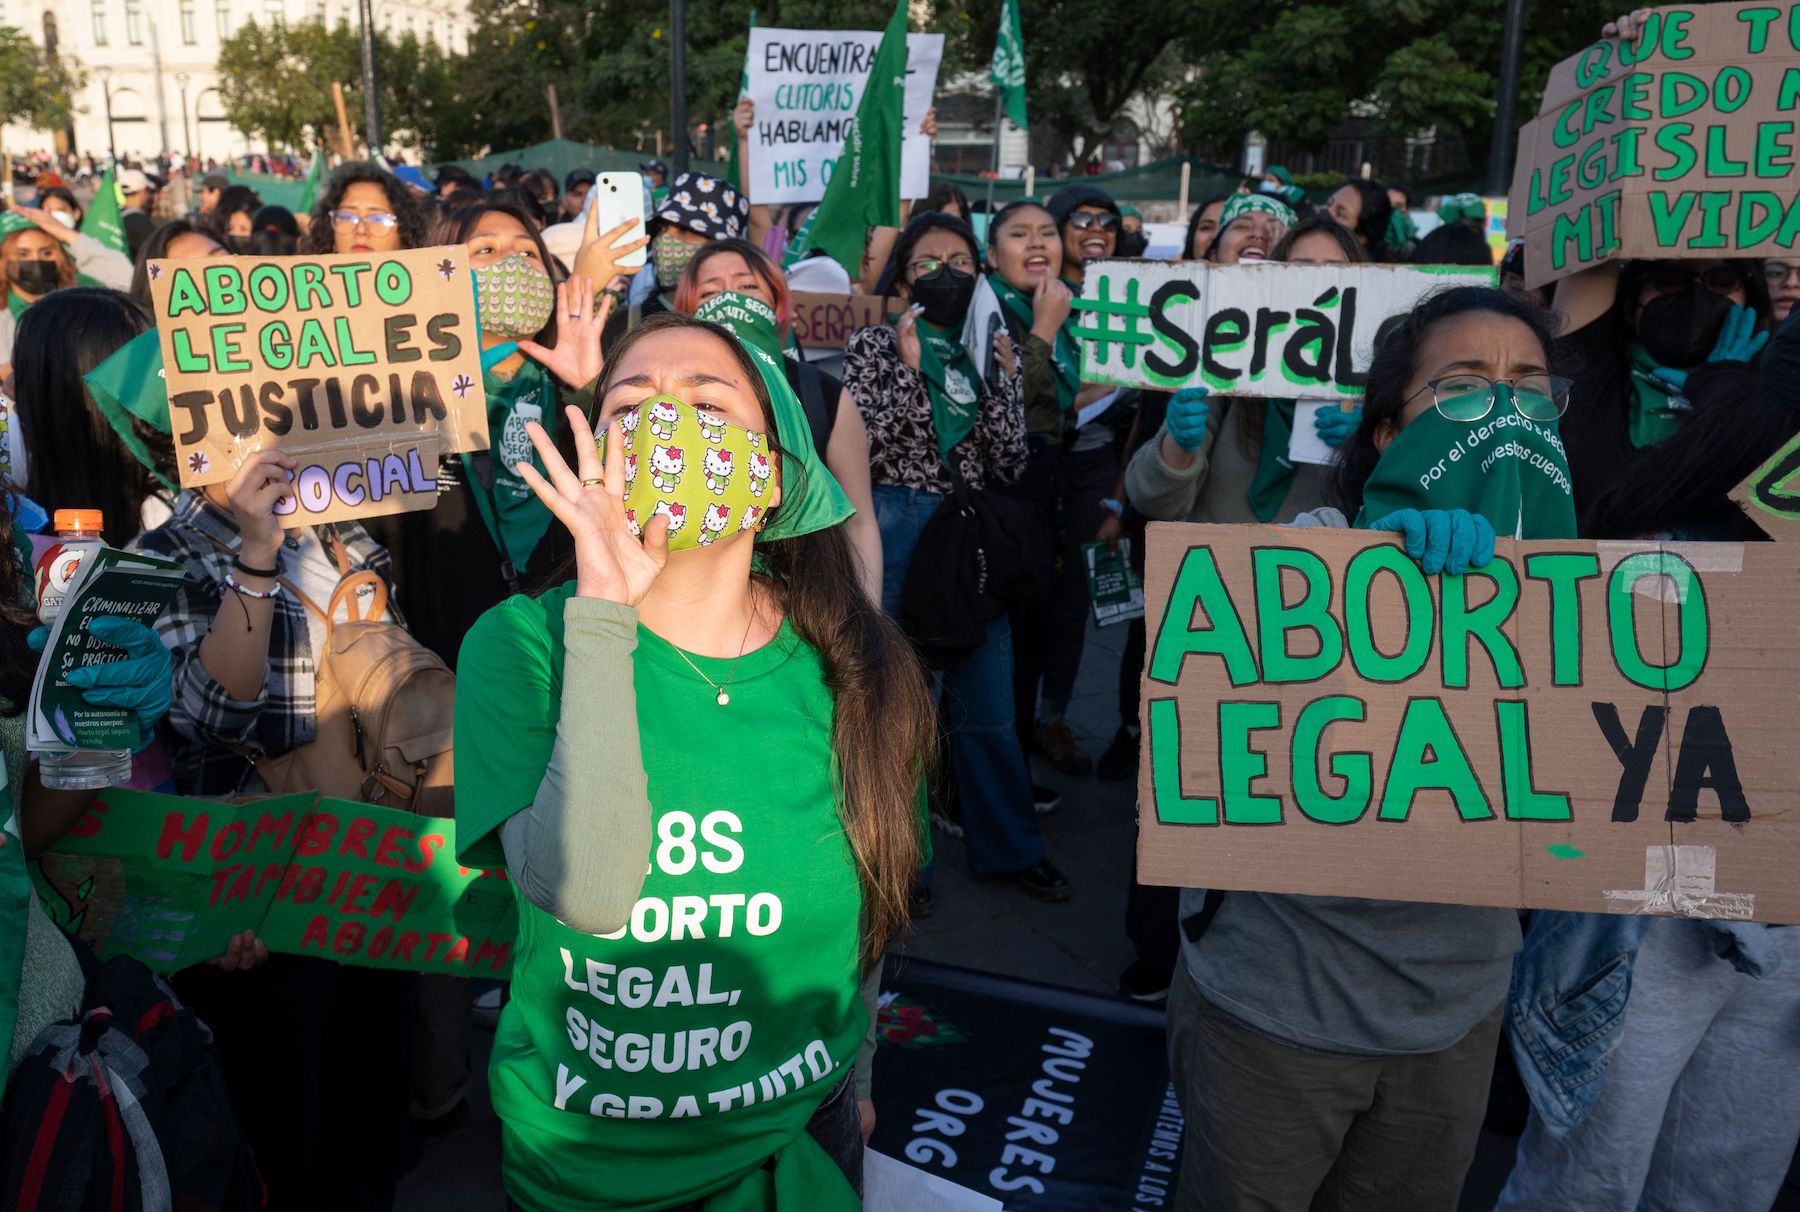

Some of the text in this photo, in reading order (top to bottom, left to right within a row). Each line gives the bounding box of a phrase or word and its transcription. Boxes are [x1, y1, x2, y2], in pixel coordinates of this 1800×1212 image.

[765, 42, 877, 75] ENCUENTRA
[1575, 10, 1696, 90] QUE
[775, 82, 854, 112] CLITORIS
[1552, 65, 1754, 149] CREDO
[774, 159, 807, 189] MIS
[1527, 120, 1795, 217] LEGISLE
[1551, 188, 1623, 271] MI
[168, 259, 413, 317] ABORTO
[704, 292, 740, 313] LEGAL
[171, 313, 462, 374] LEGAL ES
[794, 296, 855, 341] SERÁ
[169, 370, 447, 446] JUSTICIA
[1419, 458, 1447, 490] por
[1448, 441, 1466, 462] el
[1467, 412, 1533, 447] derecho
[1529, 453, 1572, 496] cuerpos
[43, 596, 64, 607] GAT
[81, 597, 161, 615] CRIMINALIZAR
[1147, 543, 1712, 693] ABORTO
[65, 634, 81, 647] NO
[90, 710, 120, 718] autonomía
[1147, 694, 1752, 827] LEGAL YA
[156, 810, 446, 874] HOMBRES
[647, 809, 745, 876] 8S
[208, 863, 422, 922] TAMBIEN
[556, 892, 783, 943] ORTO
[300, 913, 513, 970] ABORTAM
[559, 946, 742, 1008] LEGAL,
[565, 1006, 753, 1073] SEGURO
[553, 1062, 588, 1111] Y
[988, 1027, 1095, 1195] MUJERES
[1135, 1175, 1169, 1206] LOS
